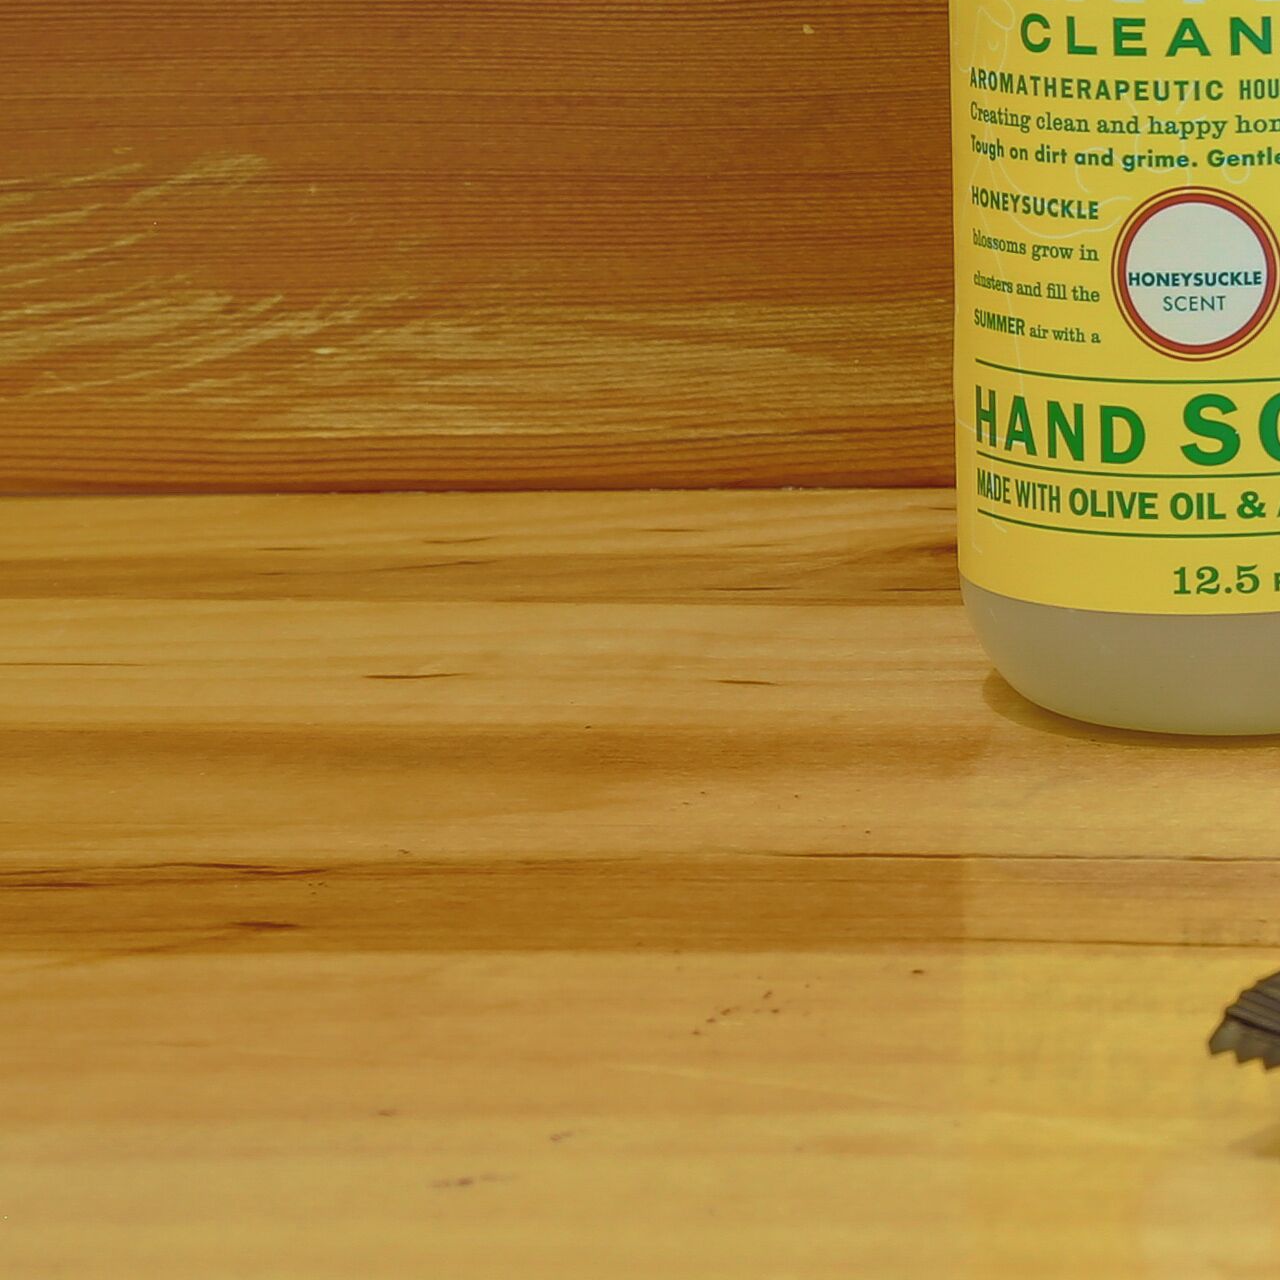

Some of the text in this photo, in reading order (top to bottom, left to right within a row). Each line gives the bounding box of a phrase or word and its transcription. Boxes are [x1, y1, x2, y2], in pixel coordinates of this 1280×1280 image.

[1021, 13, 1273, 57] CLEAN
[970, 67, 1224, 101] AROMATHERAPEUTIC
[970, 101, 1031, 133] Creating
[1036, 112, 1090, 132] clean
[1096, 116, 1141, 134] and
[1148, 116, 1228, 139] happy
[970, 134, 1004, 161] Tough
[1009, 145, 1029, 161] on
[1034, 143, 1068, 164] dirt
[1074, 148, 1114, 167] and
[1121, 149, 1198, 172] grime.
[971, 185, 1099, 220] HONEYSUCKLE
[972, 228, 1100, 262] blossoms grow in
[973, 271, 1100, 302] clusters and fill the
[1128, 271, 1262, 287] HONEYSUCKLE
[1163, 295, 1226, 312] SCENT
[974, 308, 1101, 344] SUMMER air with a
[975, 384, 1147, 465] HAND
[977, 468, 1011, 505] MADE
[1015, 479, 1061, 513] WITH
[1069, 488, 1158, 520] OLIVE
[1170, 492, 1226, 521] OIL
[1237, 491, 1266, 519] &
[1174, 564, 1260, 595] 12.5
